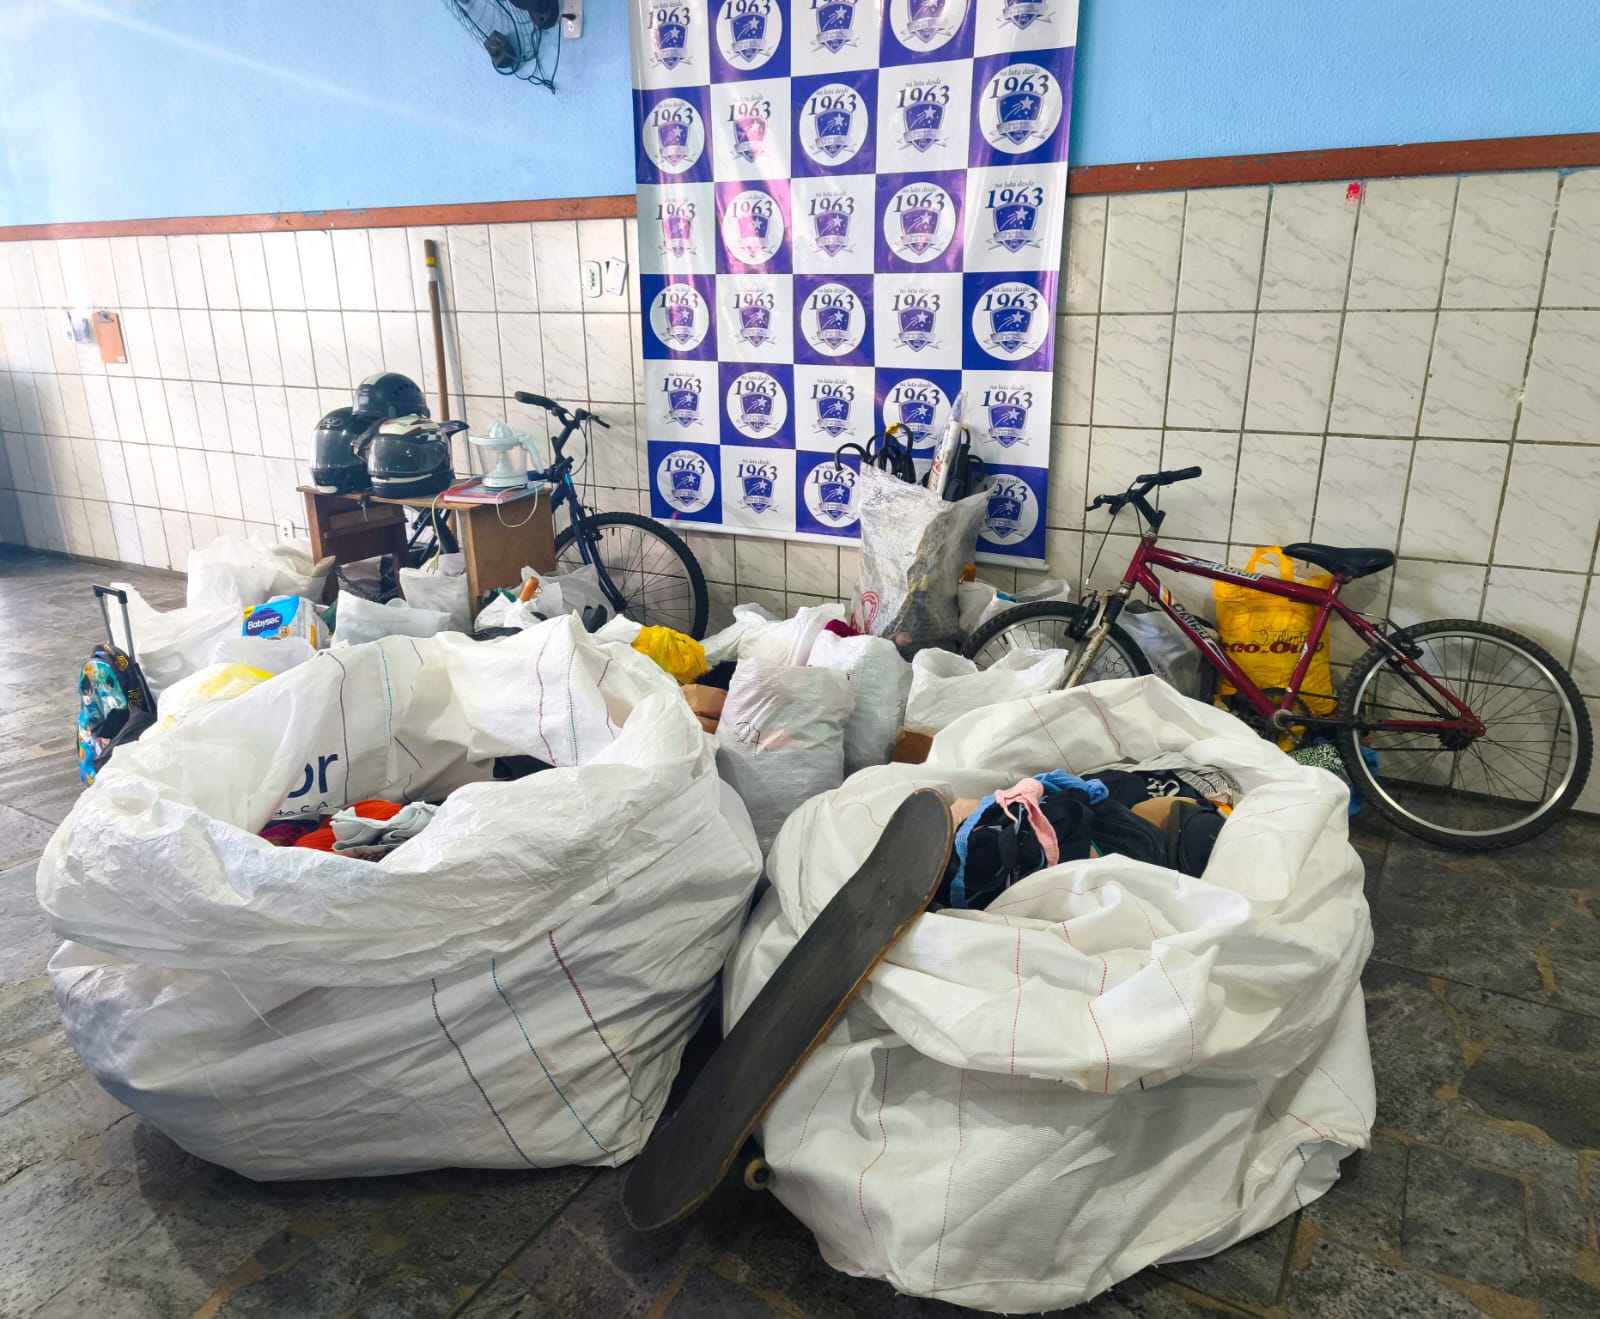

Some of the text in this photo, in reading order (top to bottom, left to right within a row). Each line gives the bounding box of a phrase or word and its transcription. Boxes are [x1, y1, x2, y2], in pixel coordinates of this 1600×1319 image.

[648, 7, 691, 29] 1963
[724, 0, 771, 20] 1963
[989, 74, 1050, 99] 1963
[808, 93, 857, 115] 1963
[896, 85, 950, 109] 1963
[652, 107, 694, 127] 1963
[727, 100, 772, 122] 1963
[808, 196, 855, 216] 1963
[893, 193, 945, 213] 1963
[985, 187, 1044, 209] 1963
[655, 203, 696, 220] 1963
[732, 199, 773, 218] 1963
[659, 292, 698, 308] 1963
[732, 293, 774, 310] 1963
[809, 293, 855, 311] 1963
[891, 293, 941, 312] 1963
[983, 292, 1038, 312] 1963
[661, 377, 702, 393] 1963
[734, 380, 777, 397] 1963
[810, 383, 855, 402] 1963
[892, 387, 941, 406] 1963
[981, 390, 1033, 409] 1963
[664, 458, 706, 475] 1963
[736, 463, 778, 481] 1963
[812, 469, 856, 488] 1963
[247, 615, 281, 630] Babysec
